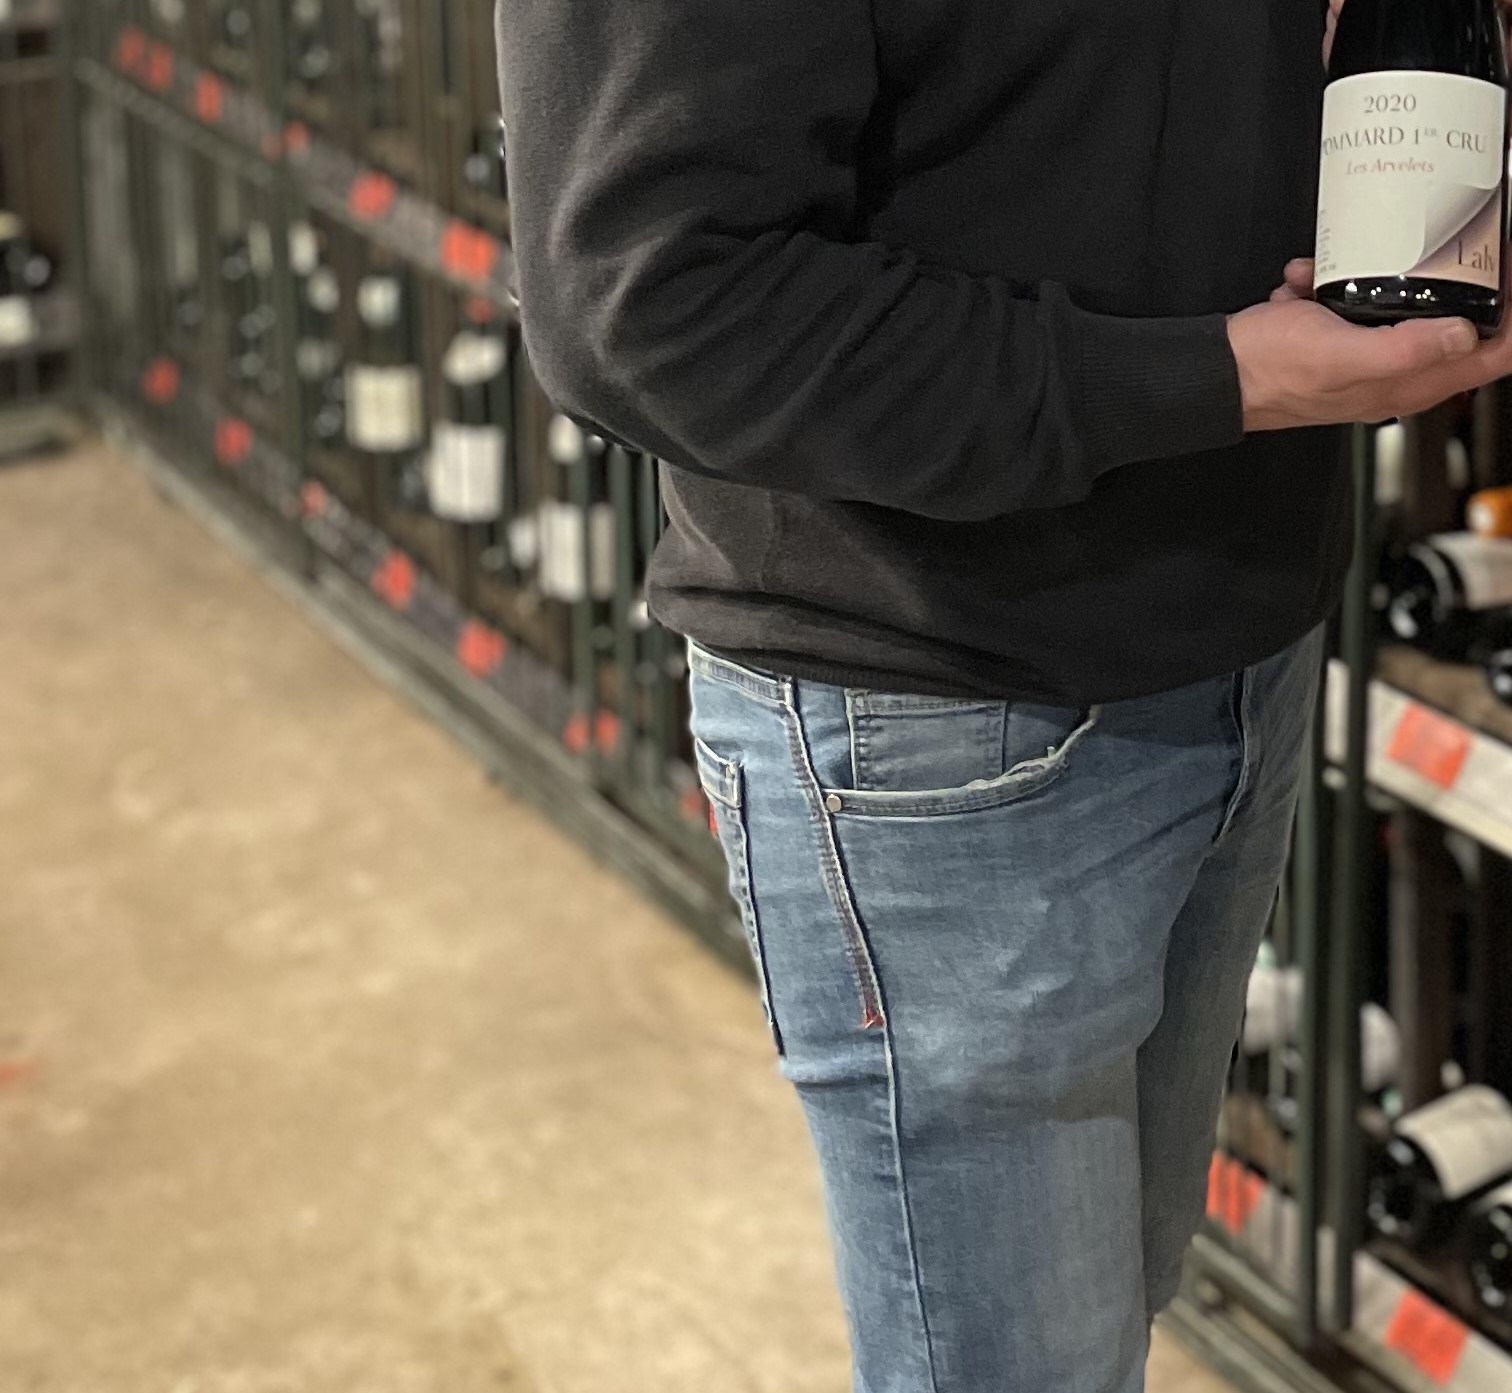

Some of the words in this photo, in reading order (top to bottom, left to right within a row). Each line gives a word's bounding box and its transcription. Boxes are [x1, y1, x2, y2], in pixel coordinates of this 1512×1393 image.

[1363, 93, 1418, 114] 2020
[1322, 126, 1405, 156] OMMARD
[1445, 129, 1488, 154] CRU
[1345, 161, 1369, 176] Les
